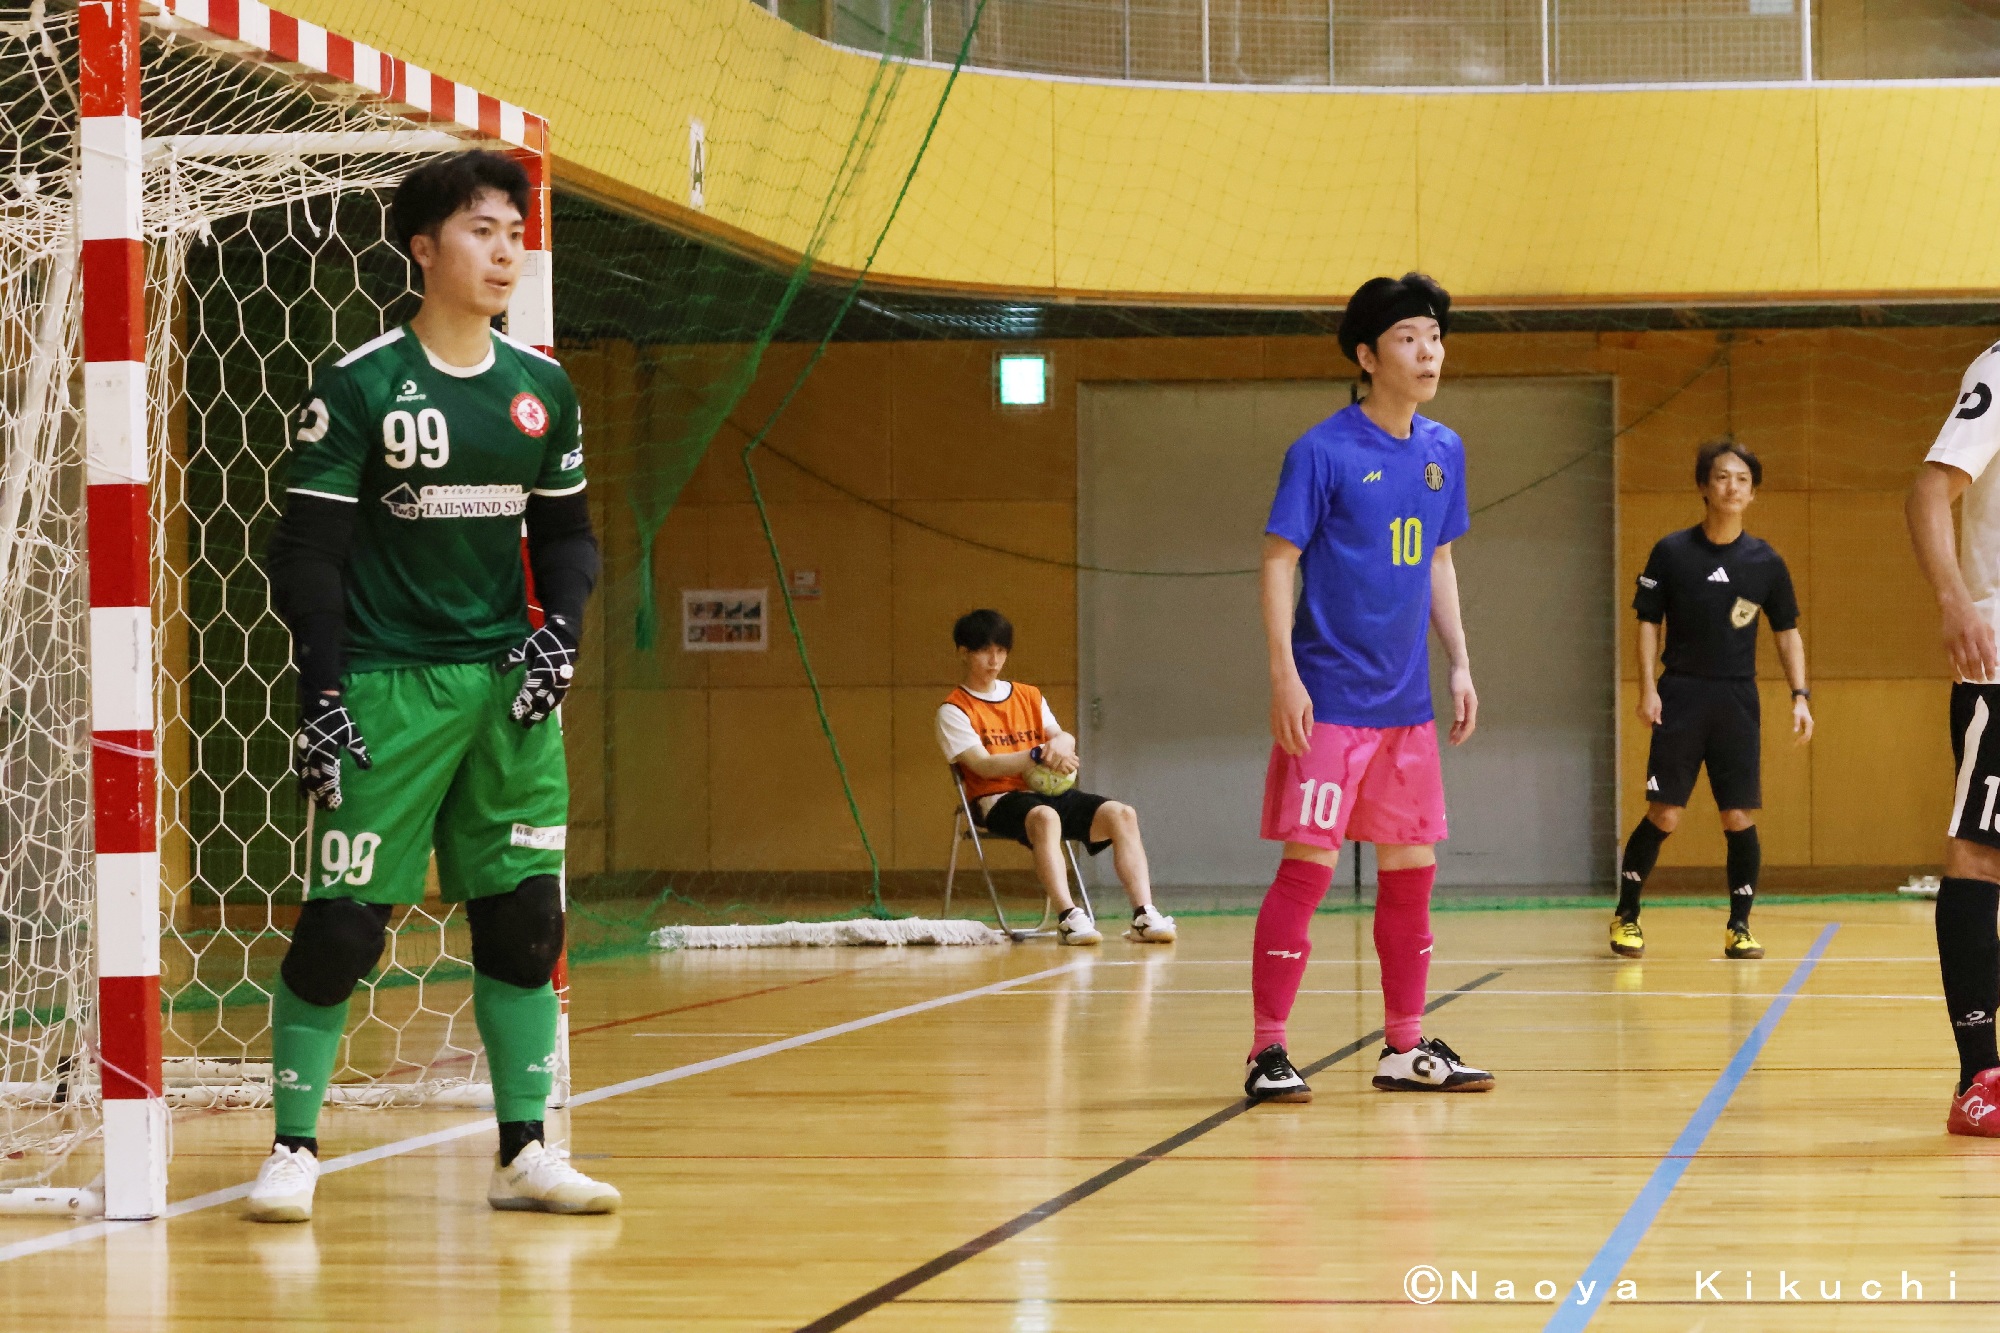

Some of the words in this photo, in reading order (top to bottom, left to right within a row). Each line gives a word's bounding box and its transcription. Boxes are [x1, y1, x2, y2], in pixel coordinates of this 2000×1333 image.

[692, 140, 702, 194] A
[382, 408, 450, 469] 99
[1390, 517, 1422, 566] 10
[1300, 778, 1343, 830] 10
[1979, 775, 2000, 833] 1
[321, 830, 382, 887] 99
